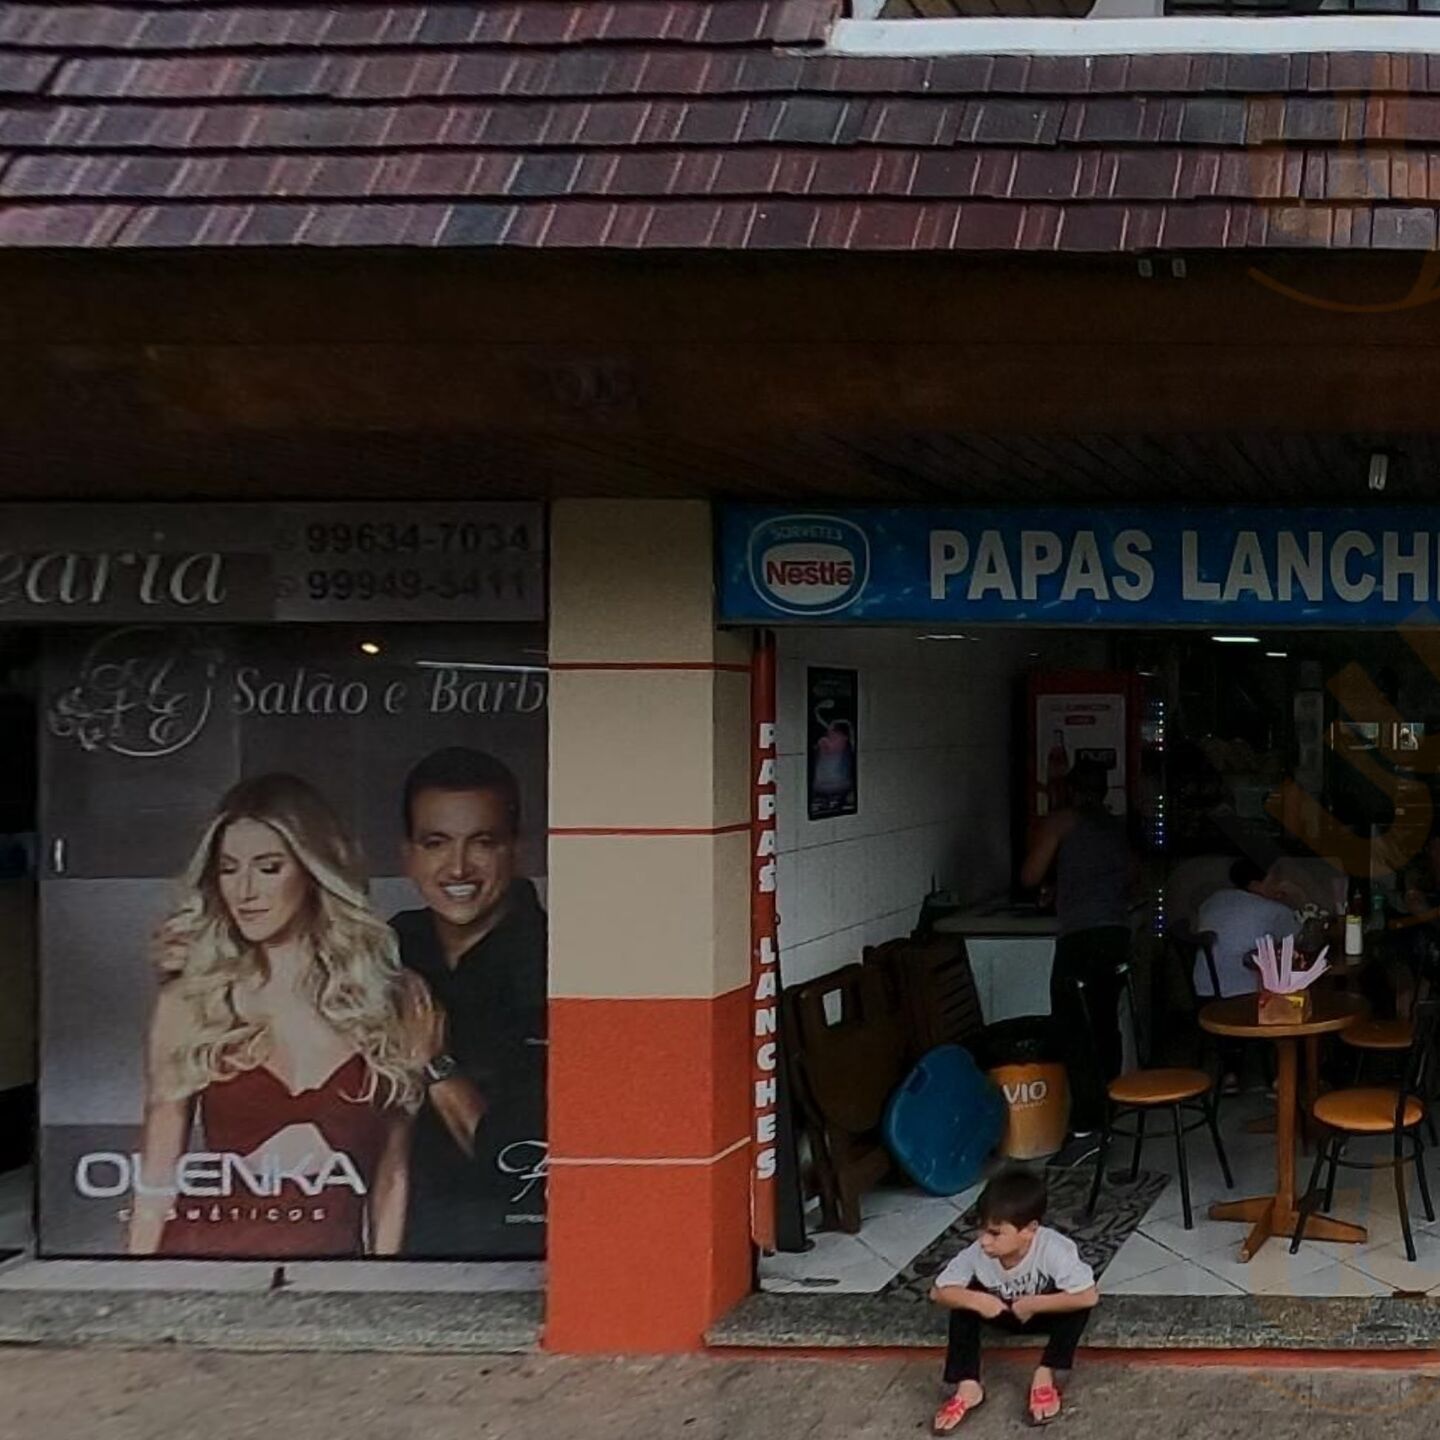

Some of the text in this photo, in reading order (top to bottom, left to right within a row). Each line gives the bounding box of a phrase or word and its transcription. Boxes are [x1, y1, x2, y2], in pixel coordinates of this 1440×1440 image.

[929, 529, 1155, 601] PAPAS
[232, 667, 369, 716] Salão
[384, 681, 406, 714] e
[755, 722, 776, 1179] PAPAS LANCHES
[74, 1151, 370, 1198] OLENKA
[116, 1203, 327, 1223] CSMÉTICOS
